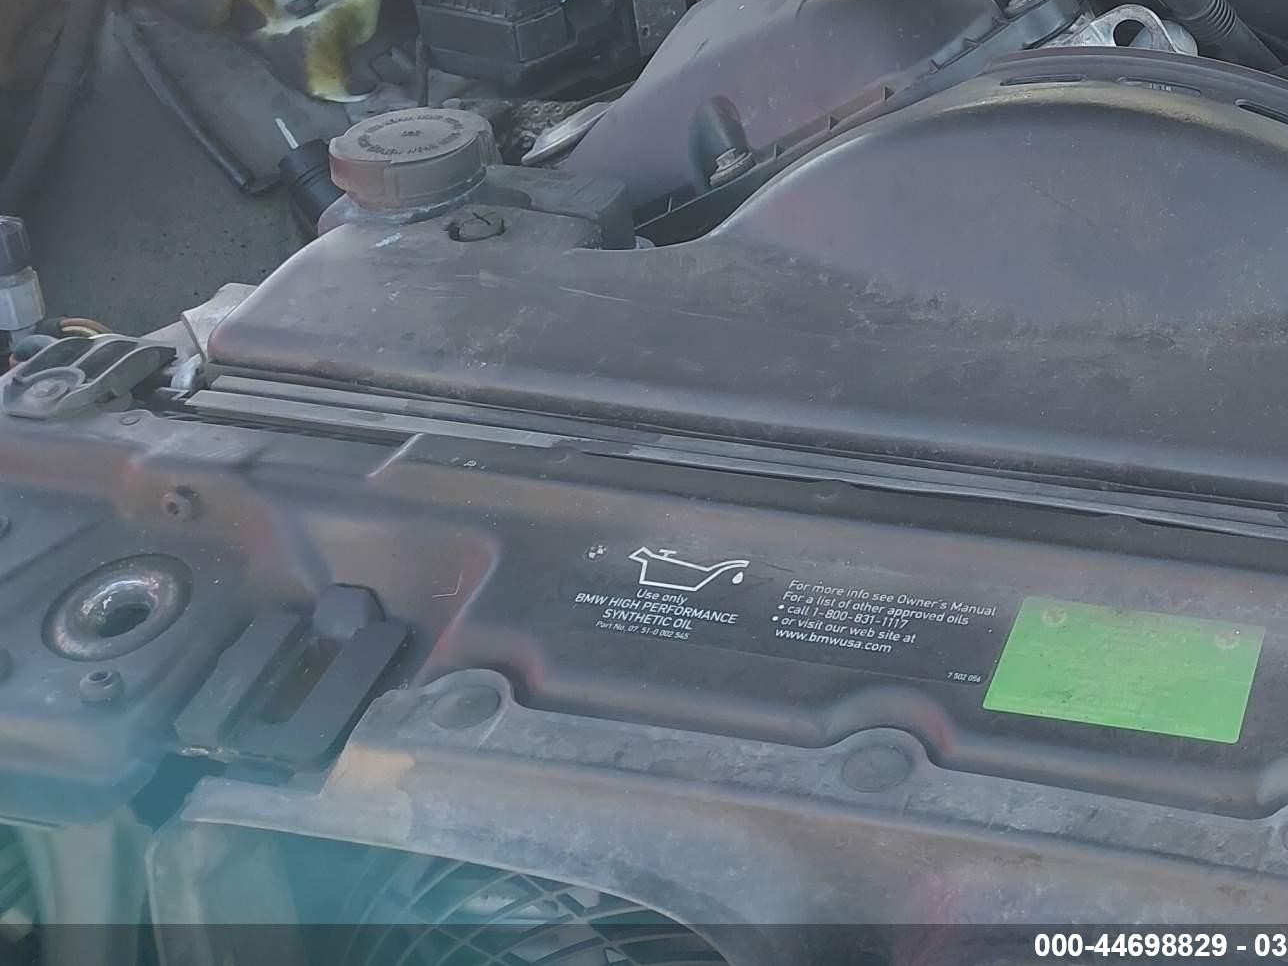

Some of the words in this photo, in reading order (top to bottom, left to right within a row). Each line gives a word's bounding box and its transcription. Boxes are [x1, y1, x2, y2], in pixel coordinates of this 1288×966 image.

[575, 592, 608, 606] BMW
[608, 597, 642, 610] HIGH
[642, 601, 740, 624] PERFORMANCE
[636, 588, 660, 600] Use
[661, 592, 689, 605] only
[782, 591, 805, 602] For
[805, 596, 814, 604] a
[816, 595, 836, 608] list
[838, 599, 854, 610] of
[853, 603, 886, 615] other
[887, 607, 945, 623] approved
[947, 614, 969, 626] oils
[788, 579, 810, 591] For
[813, 585, 845, 597] more
[846, 587, 870, 600] info
[872, 593, 895, 604] see
[950, 602, 997, 617] Manual
[595, 620, 613, 630] Part
[602, 608, 673, 627] SYNTHETIC
[673, 618, 694, 630] OIL
[787, 604, 810, 616] call
[812, 607, 910, 630] 1-800-831-1117
[774, 628, 893, 654] www.bmwusa.com
[781, 617, 797, 626] or
[798, 618, 824, 631] visit
[826, 622, 848, 634] our
[849, 626, 876, 638] web
[878, 629, 901, 642] site
[902, 633, 917, 644] at
